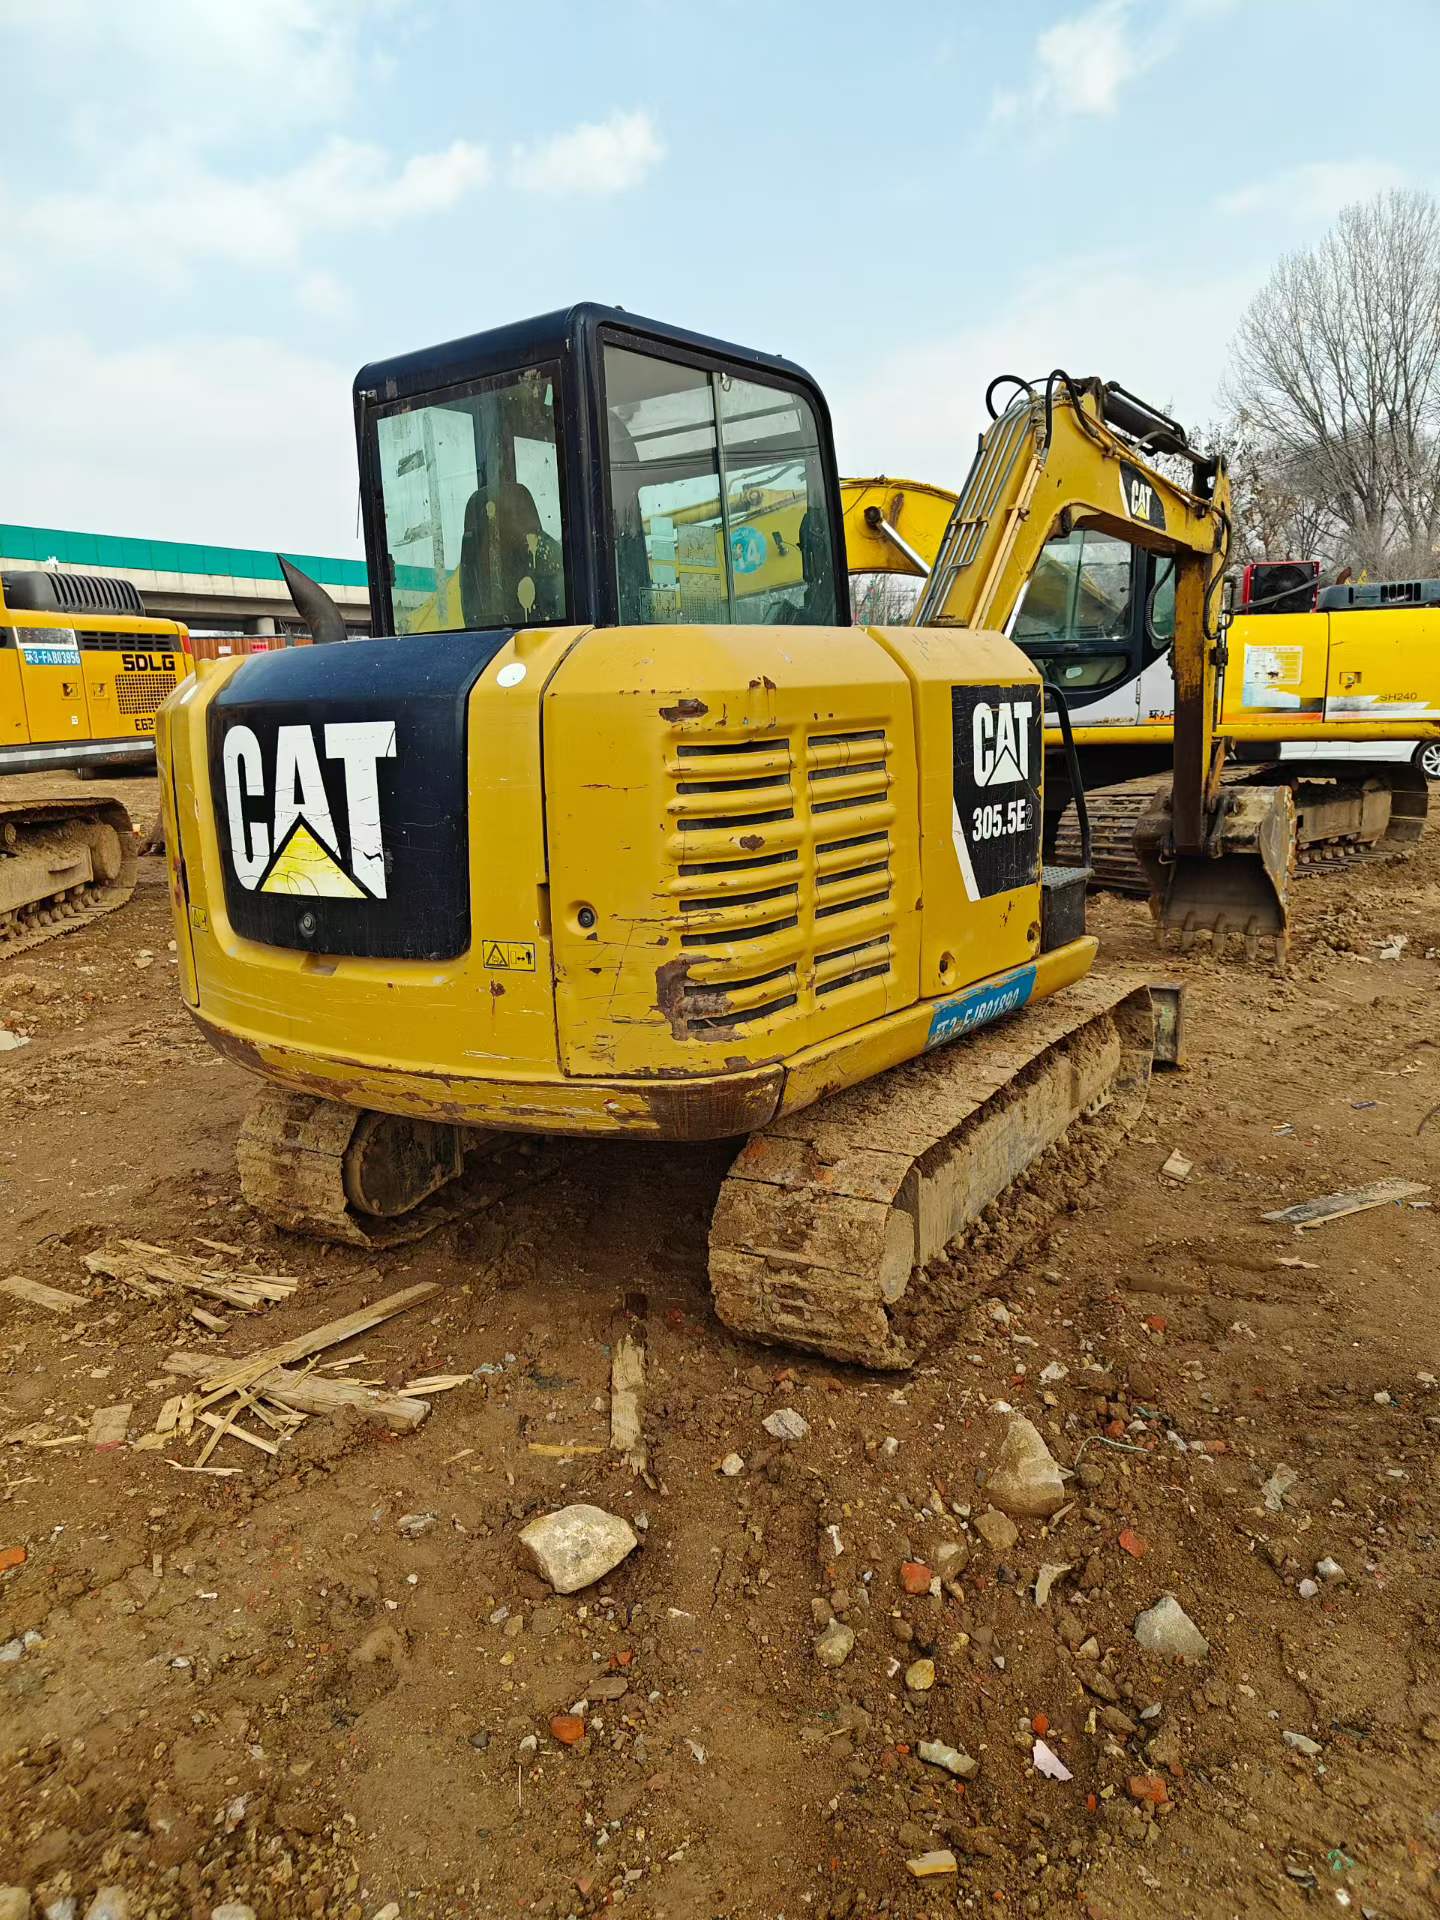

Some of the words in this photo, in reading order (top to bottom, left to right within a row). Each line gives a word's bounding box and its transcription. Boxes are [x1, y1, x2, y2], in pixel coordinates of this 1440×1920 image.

[1131, 479, 1153, 520] CAT
[121, 653, 176, 671] SDLG
[1379, 691, 1418, 702] SH240
[134, 717, 156, 731] E62
[972, 701, 1033, 787] CAT
[223, 721, 397, 899] CAT
